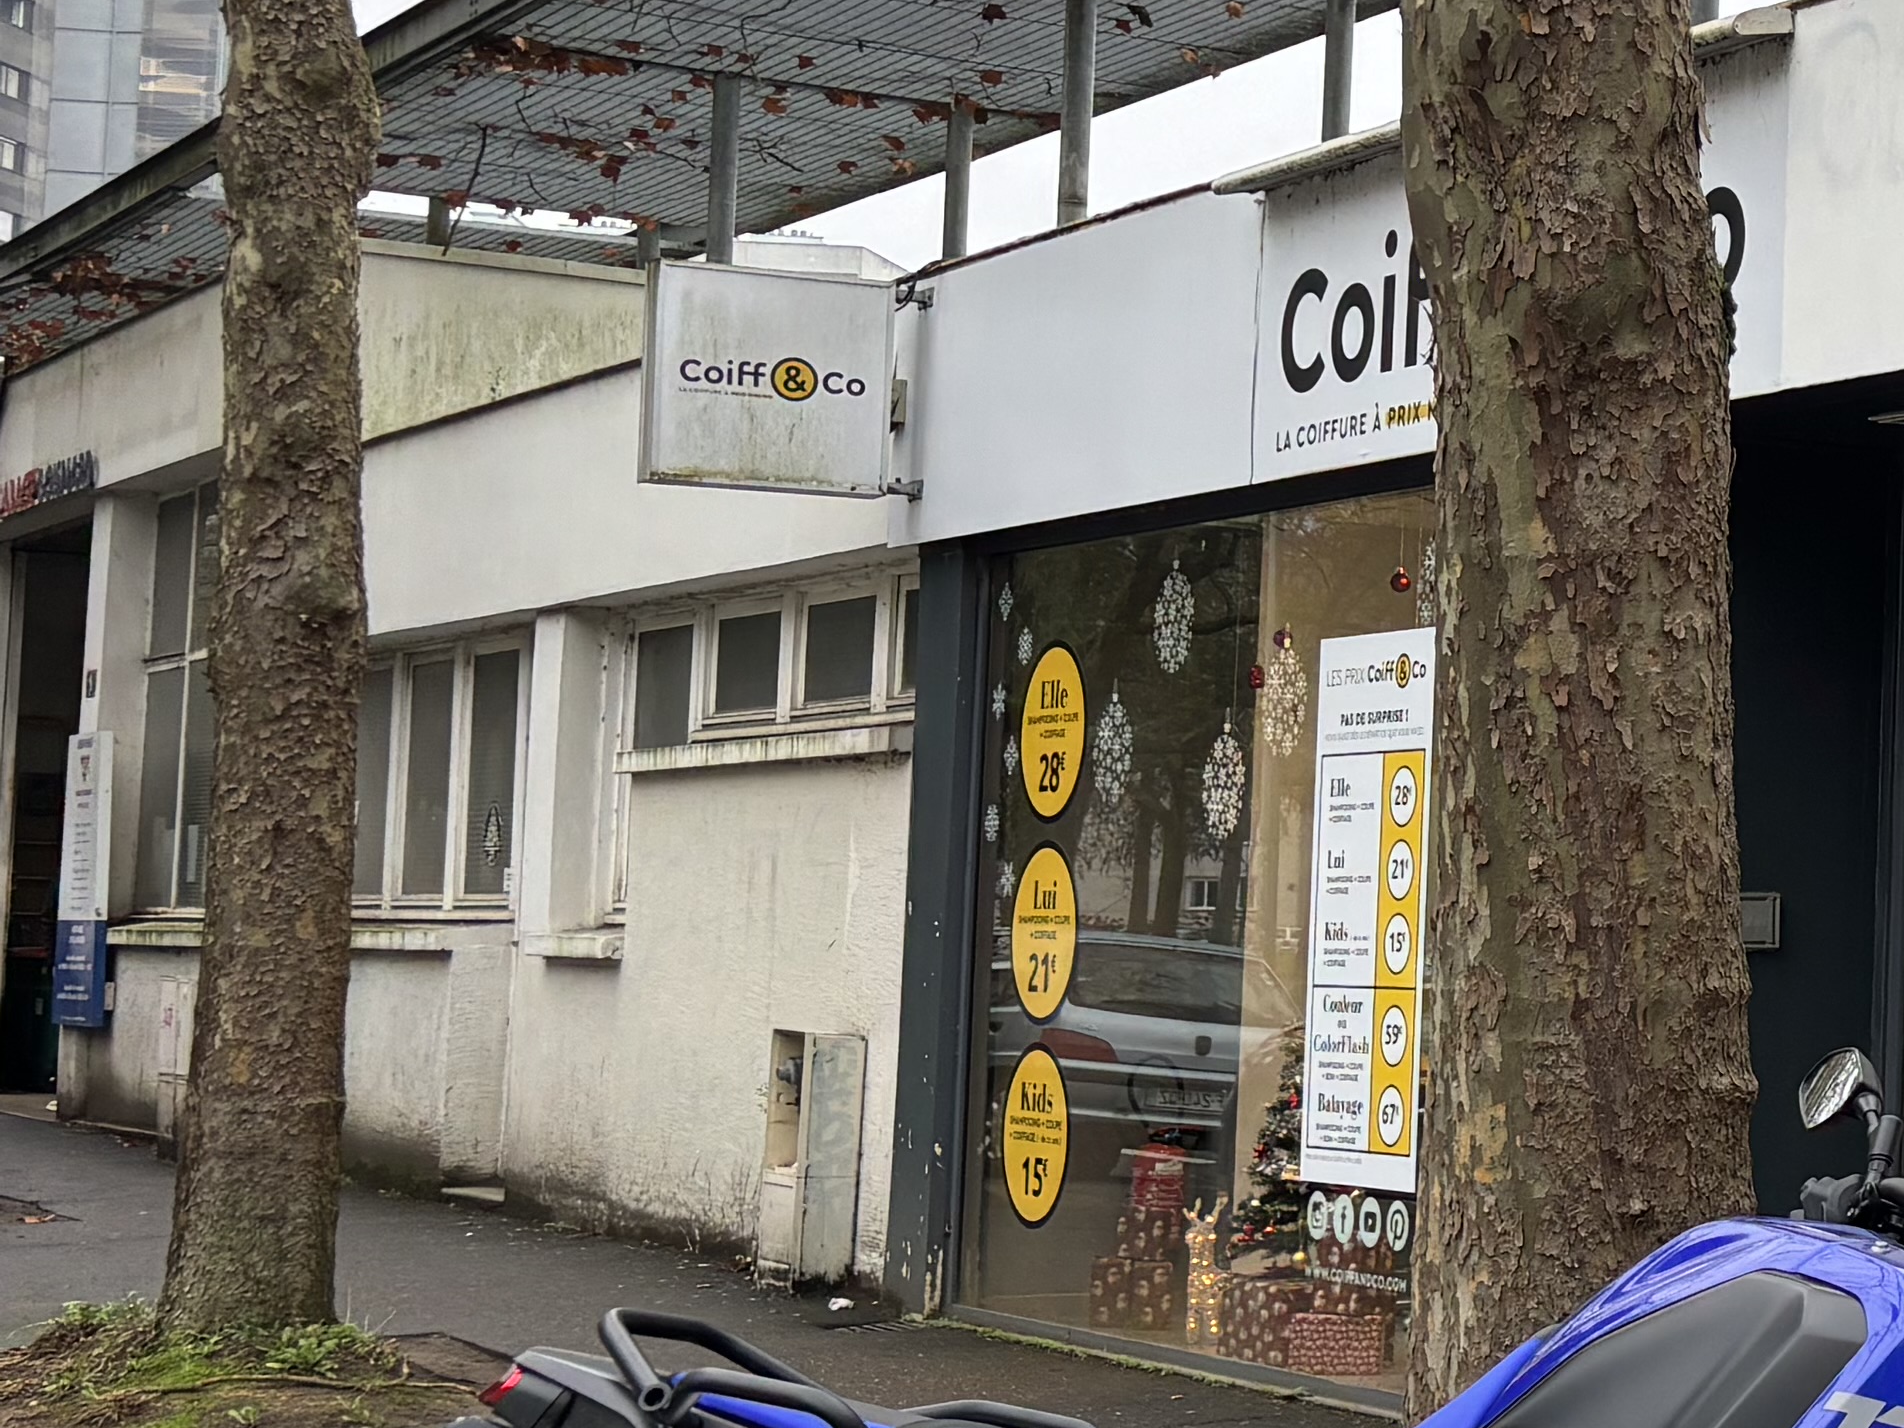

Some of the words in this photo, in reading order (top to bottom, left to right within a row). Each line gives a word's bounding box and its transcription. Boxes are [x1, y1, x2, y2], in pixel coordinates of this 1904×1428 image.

[679, 359, 767, 388] Coiff
[822, 371, 866, 397] Co
[1276, 431, 1291, 452] LA
[1296, 413, 1367, 447] COIFFURE
[1372, 402, 1382, 432] À
[1388, 400, 1422, 429] PRIX
[1412, 660, 1426, 678] Co
[1041, 680, 1068, 709] Elle
[1340, 713, 1354, 726] PAS
[1356, 712, 1366, 725] DE
[1368, 709, 1403, 725] SURPRISE
[1330, 778, 1350, 797] Elle
[1328, 849, 1345, 869] Lui
[1034, 880, 1057, 910] Lui
[1325, 921, 1348, 941] Kids
[1020, 1082, 1053, 1113] Kids
[1318, 1093, 1364, 1120] Balayage
